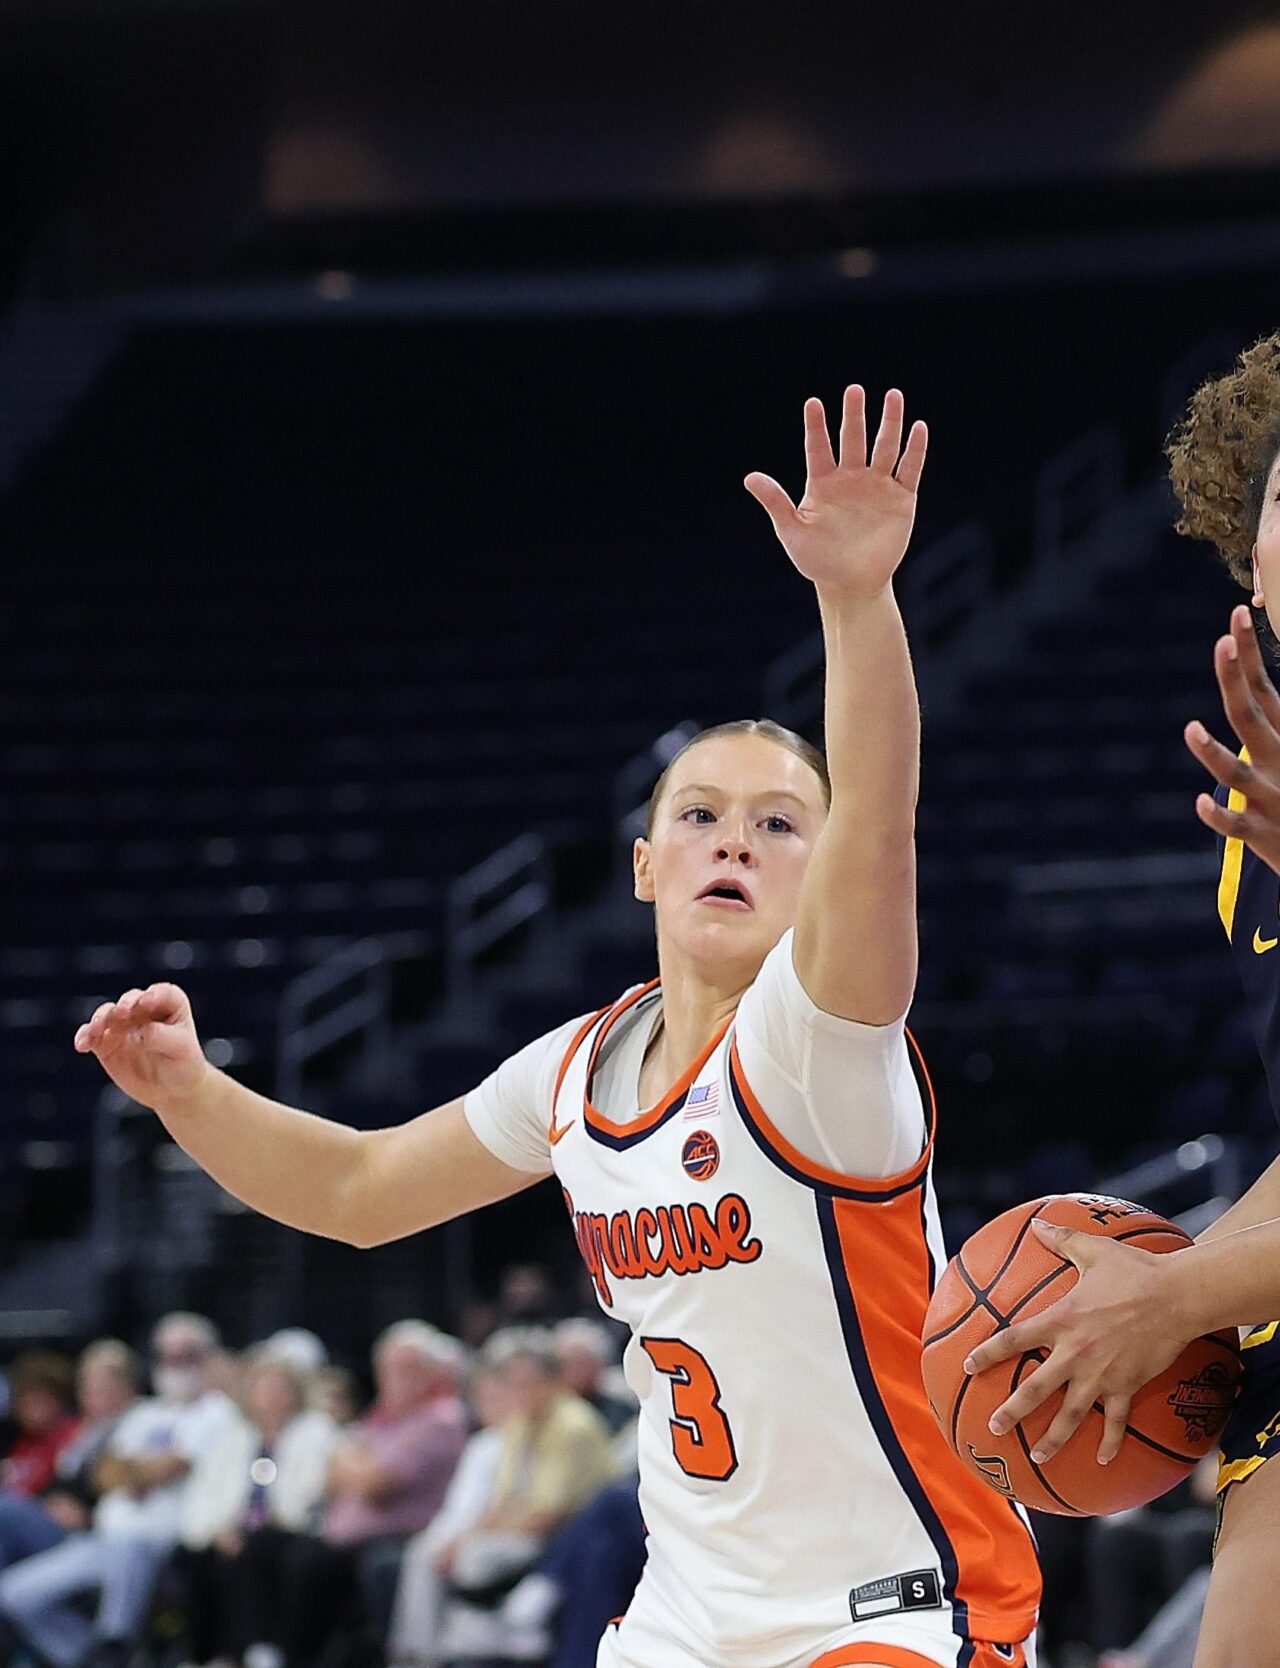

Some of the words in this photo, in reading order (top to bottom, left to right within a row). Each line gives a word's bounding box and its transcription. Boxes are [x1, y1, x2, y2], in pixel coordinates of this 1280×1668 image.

[562, 1187, 763, 1308] yracuse
[640, 1336, 739, 1482] 3
[911, 1580, 926, 1599] S
